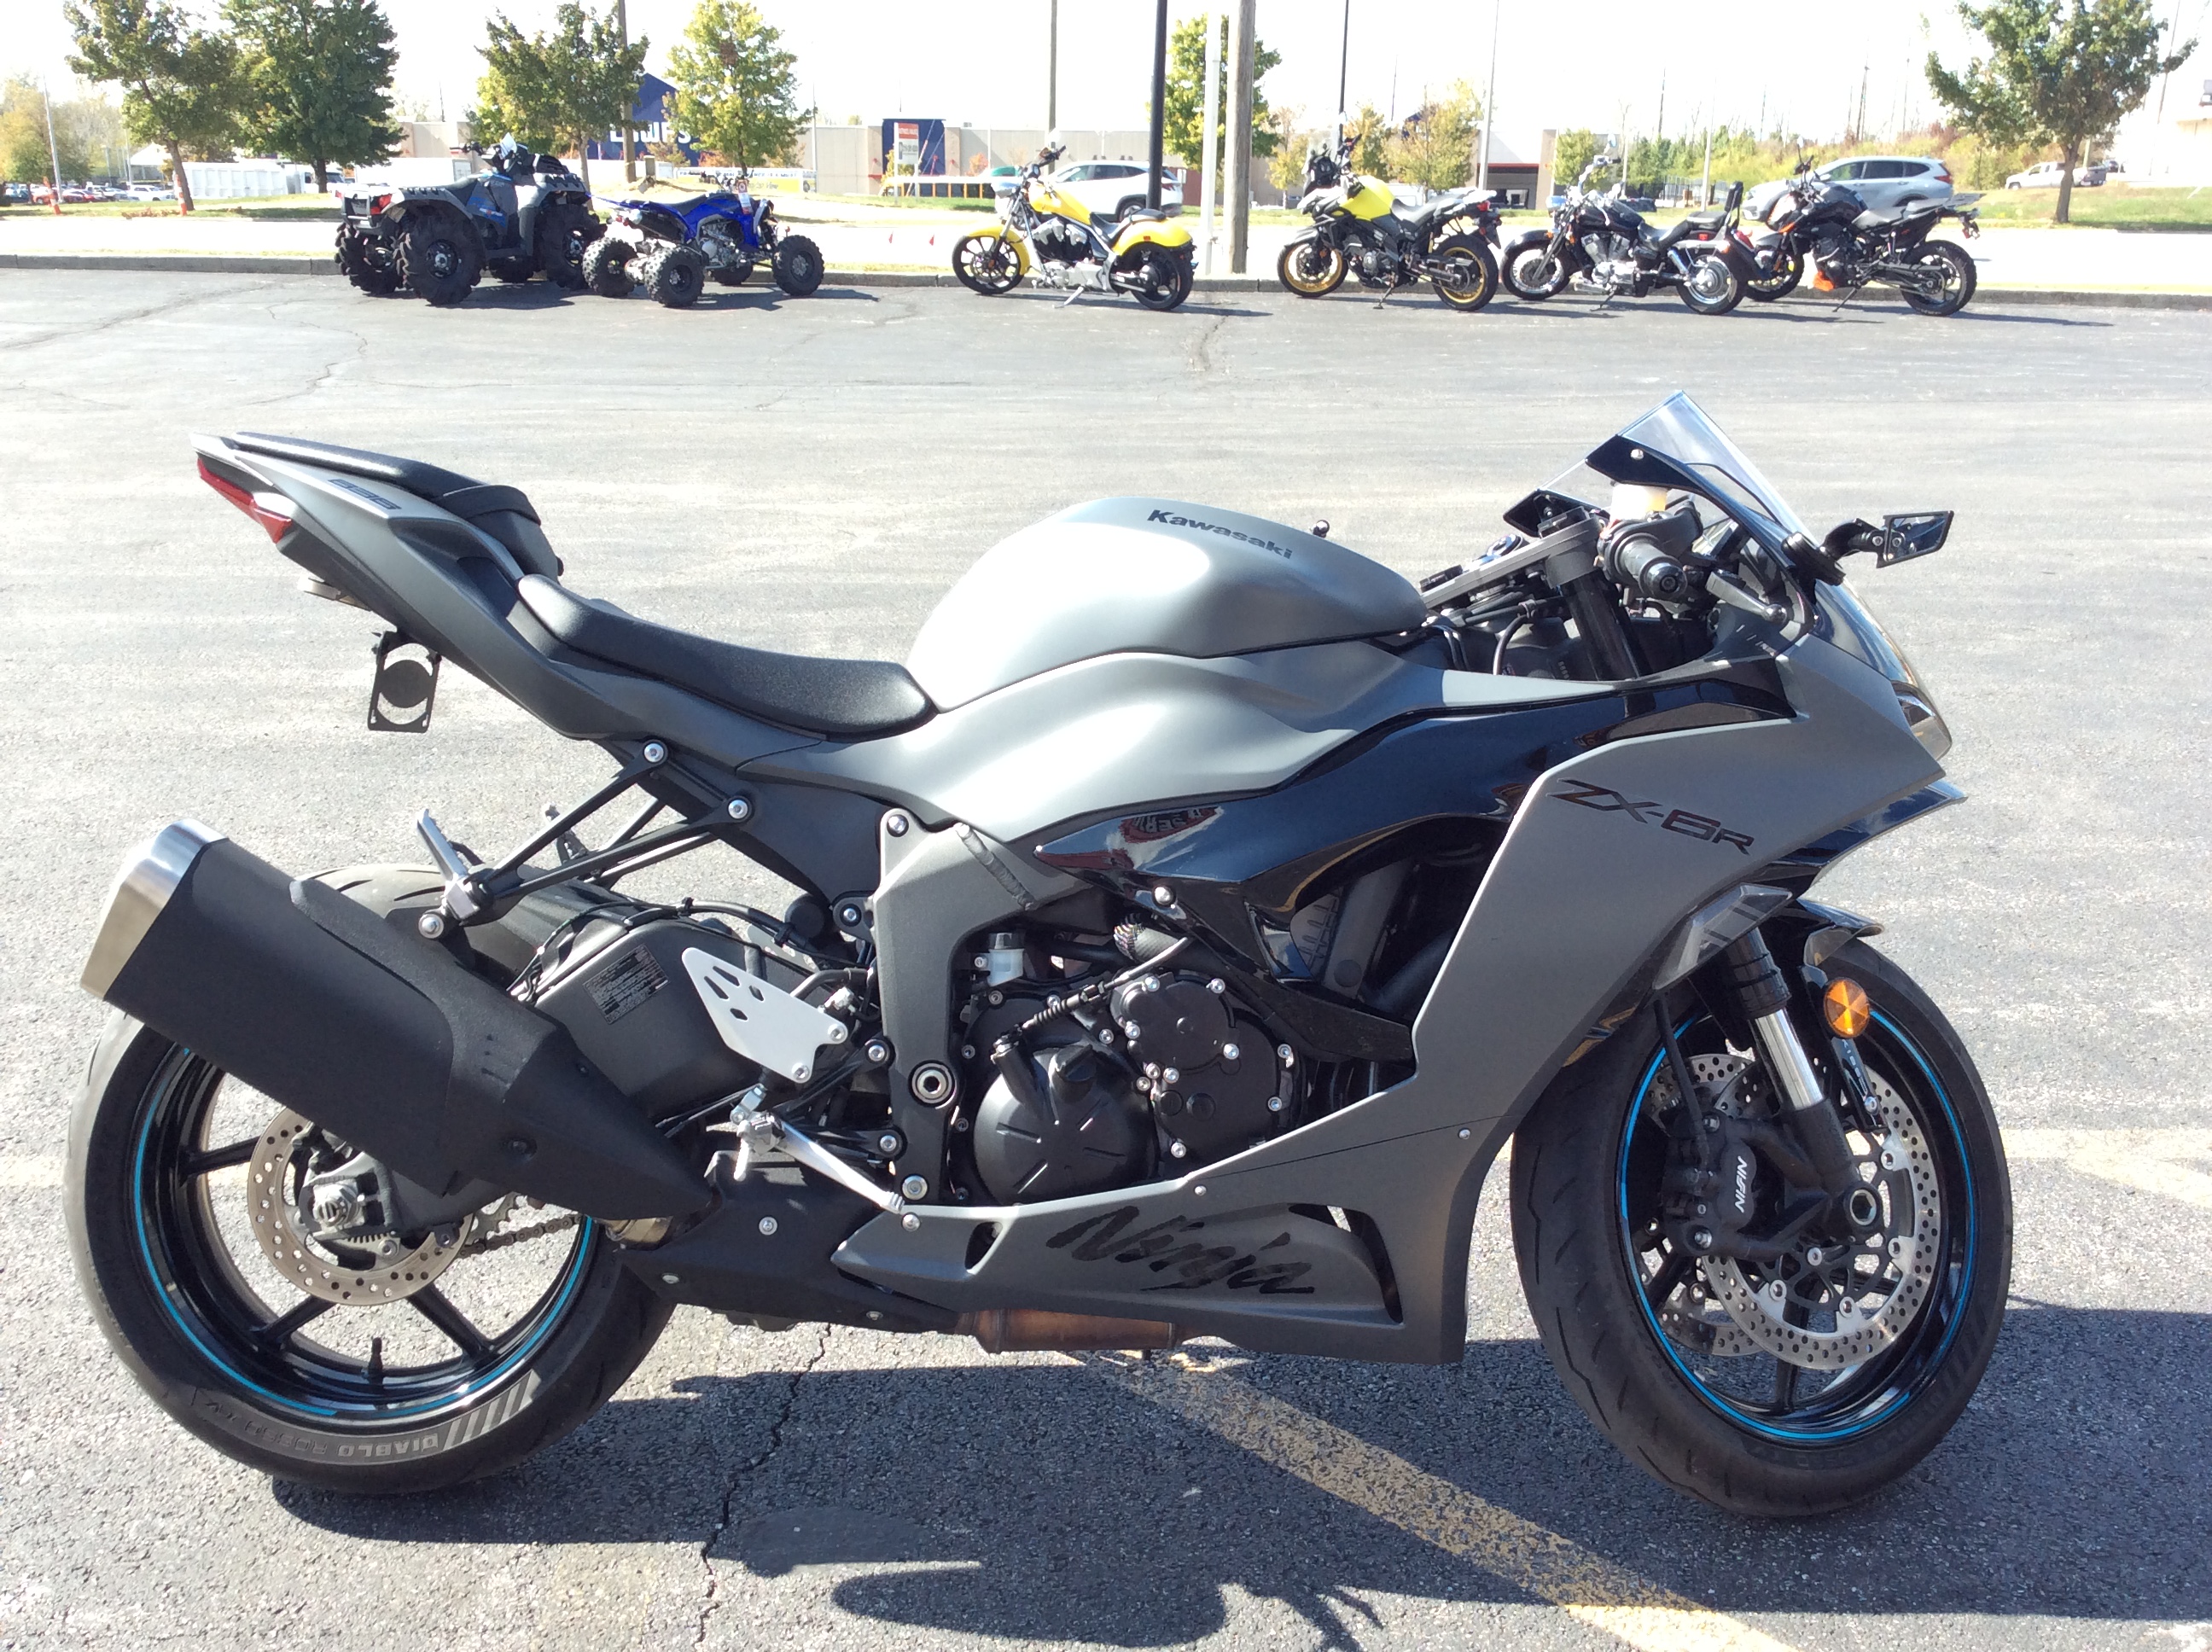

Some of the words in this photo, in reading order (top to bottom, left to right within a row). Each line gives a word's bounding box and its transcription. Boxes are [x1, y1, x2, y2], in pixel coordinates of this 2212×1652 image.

[1146, 509, 1293, 560] Kawasaki
[1545, 777, 1755, 856] ZX-6R
[1045, 1205, 1315, 1294] Ninja
[244, 1420, 328, 1455] ROSSO
[337, 1433, 439, 1457] DIABLO
